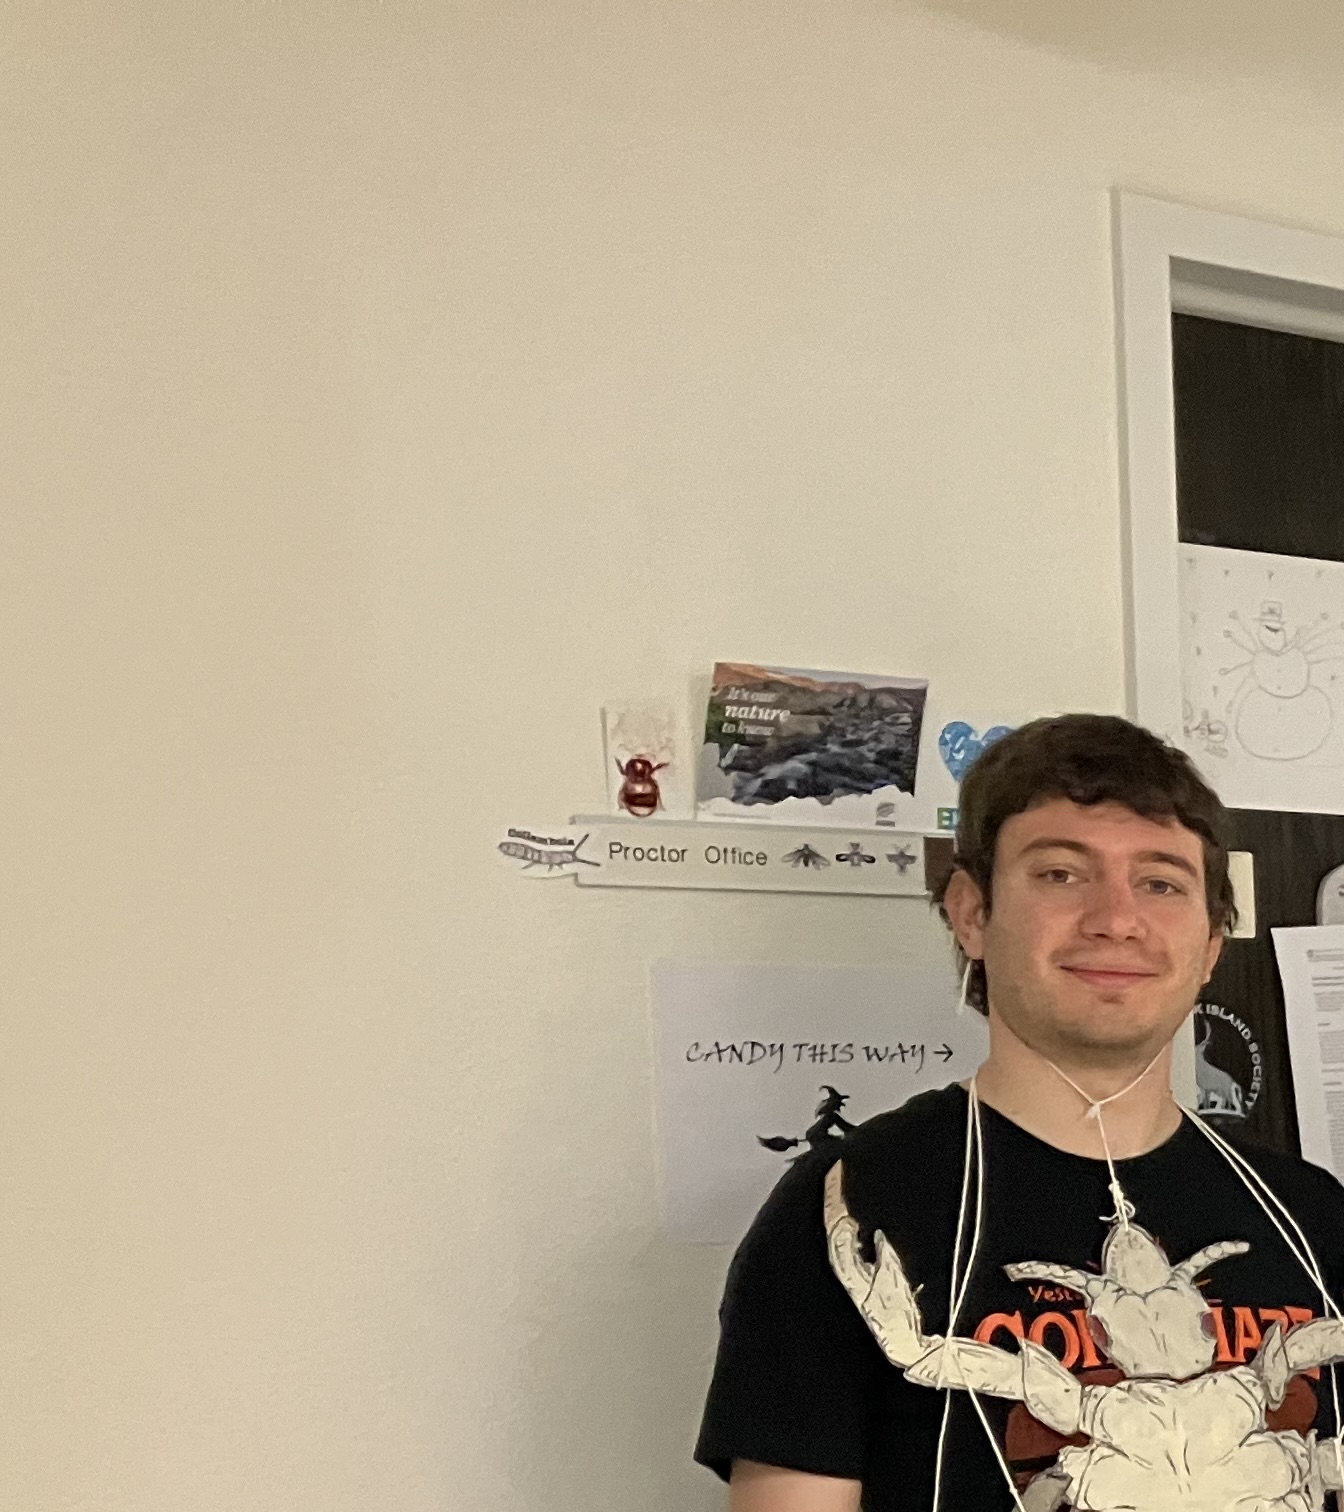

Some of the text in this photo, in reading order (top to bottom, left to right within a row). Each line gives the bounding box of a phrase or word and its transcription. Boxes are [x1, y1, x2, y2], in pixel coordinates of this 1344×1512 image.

[725, 704, 791, 722] nature
[608, 841, 768, 866] Proctor Office
[686, 1041, 925, 1074] CANDY THIS WAY
[1206, 1003, 1262, 1110] ISLAND SOCIETY
